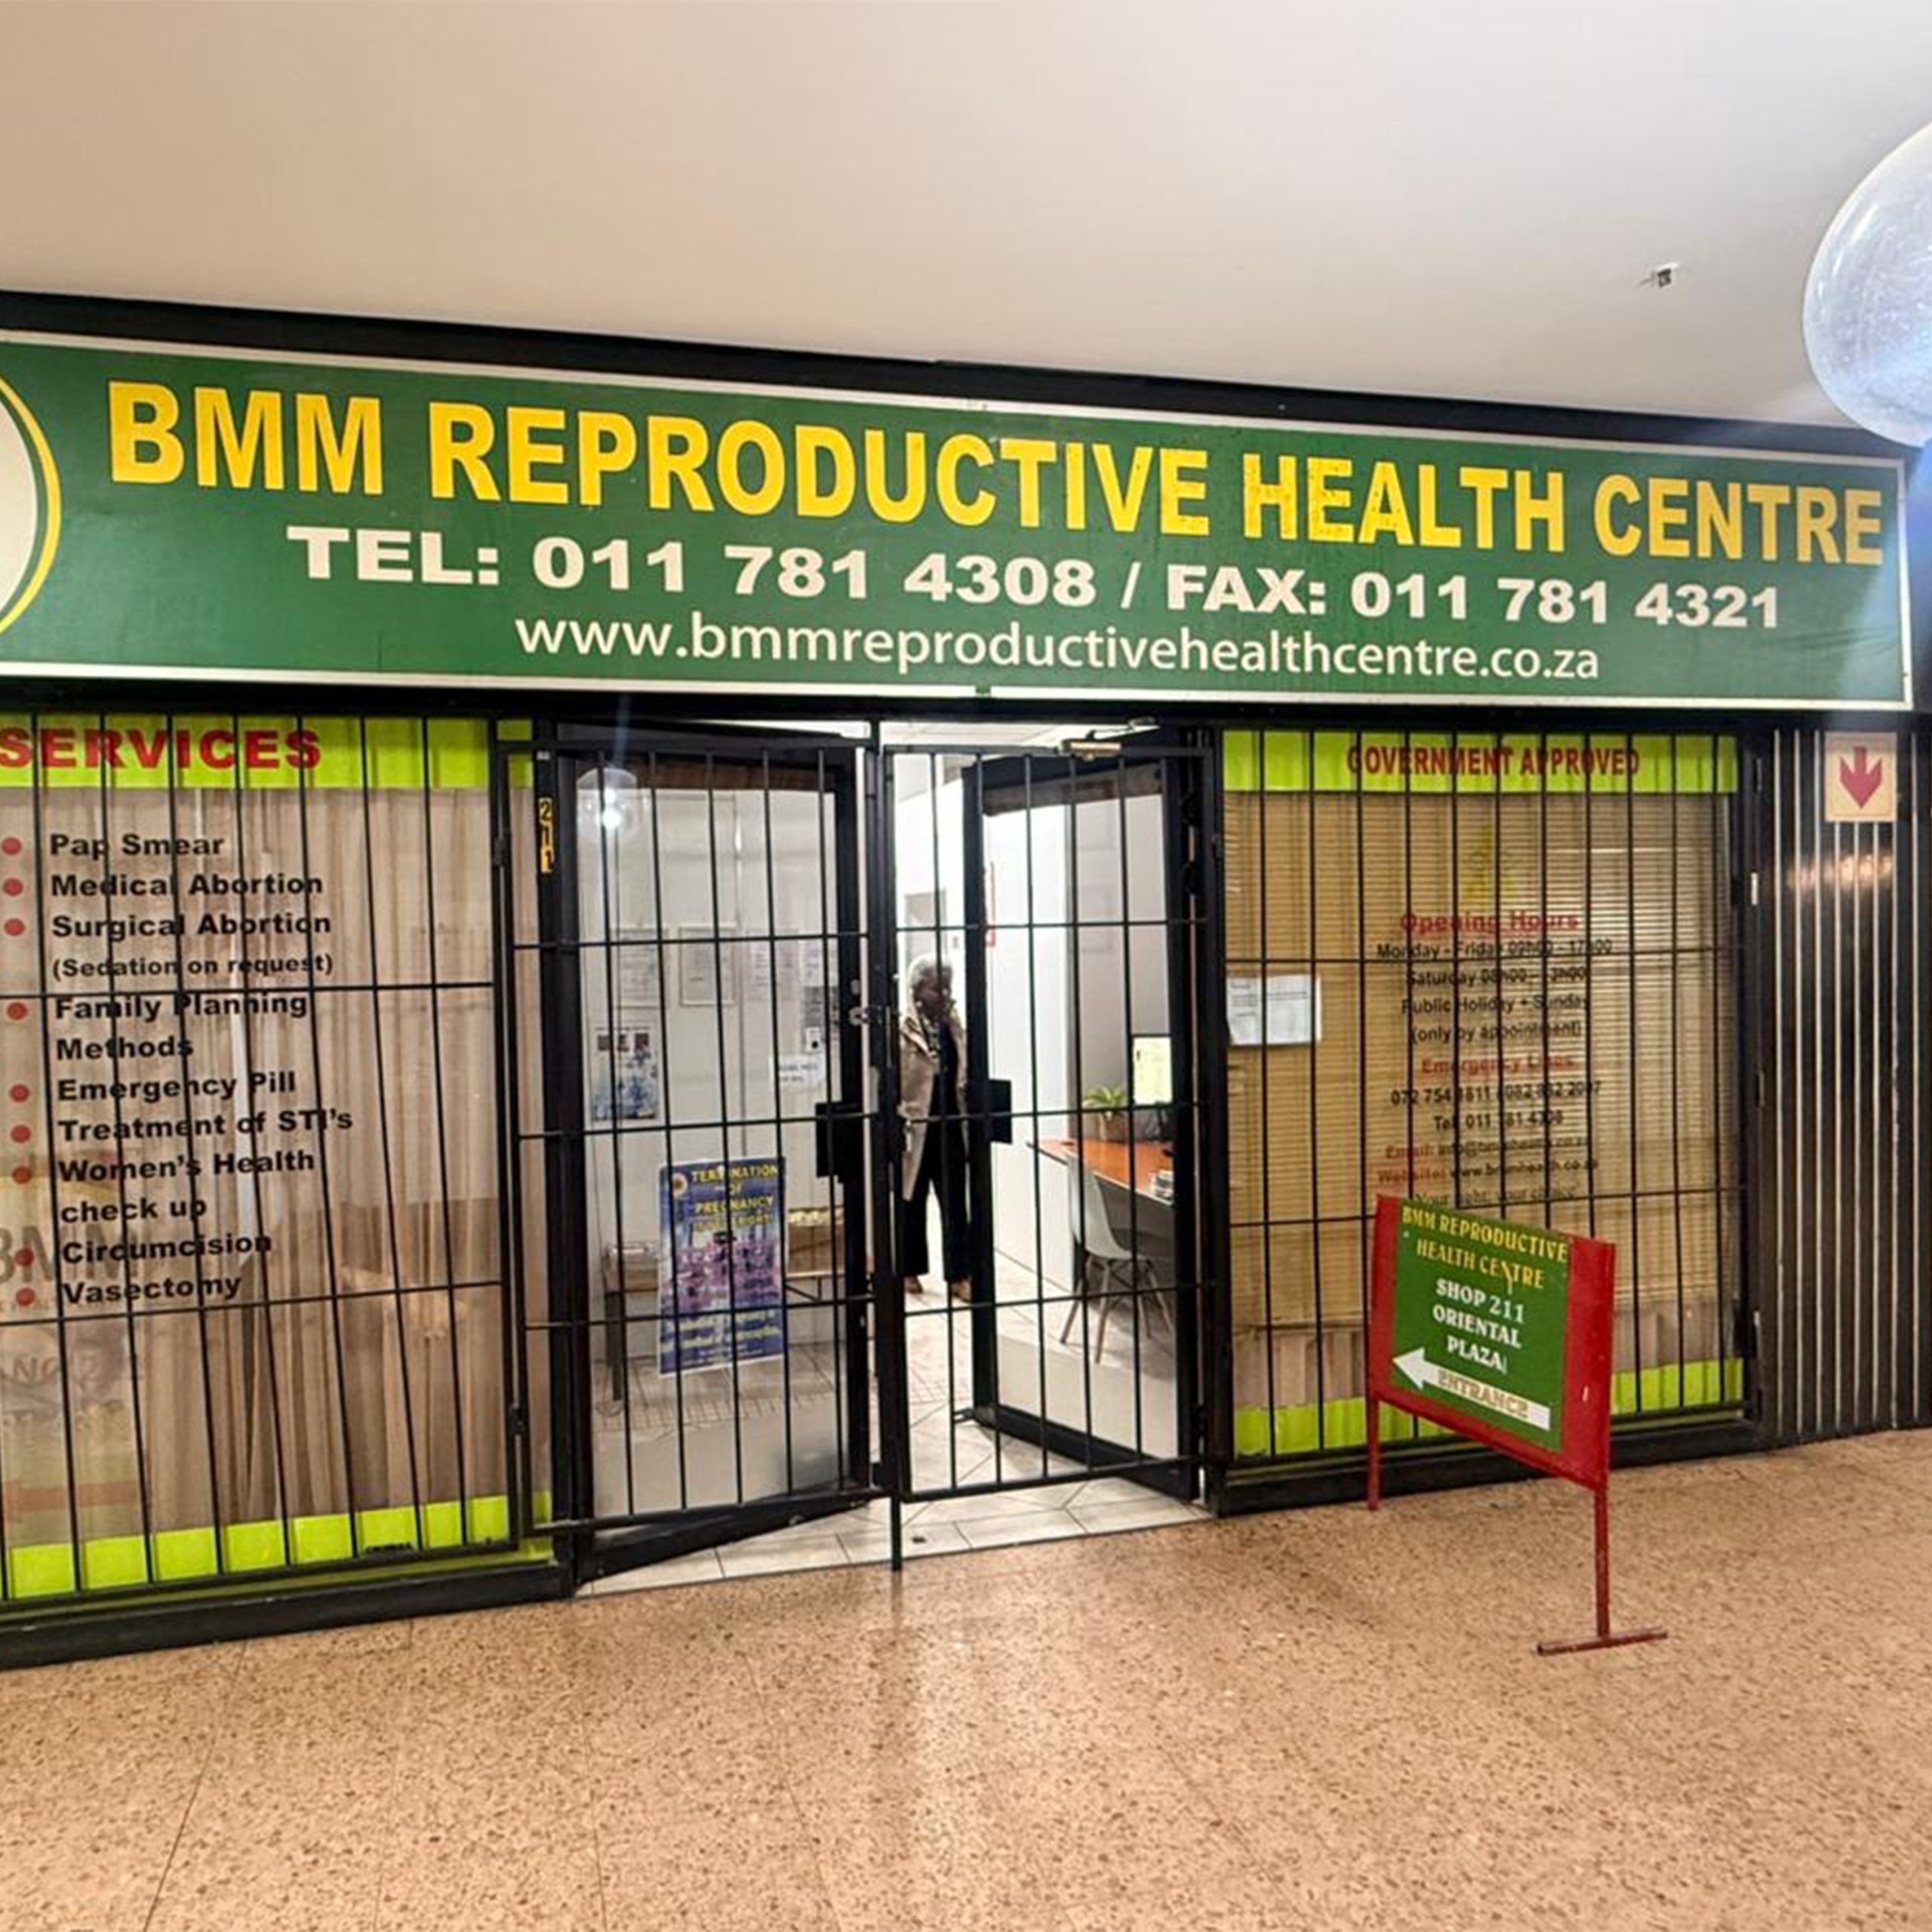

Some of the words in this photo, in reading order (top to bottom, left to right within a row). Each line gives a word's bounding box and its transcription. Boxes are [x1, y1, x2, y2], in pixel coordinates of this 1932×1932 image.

[109, 380, 383, 495] BMM
[429, 401, 1210, 536] REPRODUCTIVE
[1244, 454, 1564, 552] HEALTH
[1593, 474, 1884, 566] CENTRE
[287, 526, 500, 585] TEL:
[533, 537, 685, 592] 011
[724, 545, 866, 598] 781
[904, 553, 1097, 607] 4308
[1167, 565, 1326, 615] FAX:
[1351, 571, 1467, 620] 011
[1497, 579, 1607, 624] 781
[1635, 583, 1778, 629] 4321
[515, 611, 1599, 680] www.bmmreproductivehealthcentre.co.za
[0, 728, 321, 771] SERVICES
[51, 834, 109, 860] Pap
[122, 833, 226, 856] Smear
[51, 874, 175, 897] Medical
[189, 872, 323, 896] Abortion
[52, 915, 186, 942] Surgical
[198, 913, 331, 936] Abortion
[1570, 938, 1613, 955] 1700
[54, 958, 178, 980] (Sedation
[188, 958, 219, 974] on
[228, 953, 334, 978] request)
[56, 996, 162, 1022] Family
[174, 993, 308, 1019] Planning
[1534, 992, 1589, 1011] Sunda
[1479, 1020, 1583, 1041] appointent)
[57, 1036, 194, 1061] Methods
[1421, 1058, 1521, 1077] Emrgency
[58, 1076, 237, 1103] Emergency
[250, 1072, 296, 1094] Pill
[58, 1115, 226, 1142] Treatment
[237, 1111, 266, 1134] of
[214, 1150, 315, 1176] Health
[692, 1164, 778, 1185] TERMNATION
[61, 1198, 158, 1223] check
[170, 1199, 207, 1224] up
[1402, 1206, 1435, 1230] BMM
[1439, 1214, 1568, 1263] REPRODUCTIVE
[63, 1235, 272, 1264] Circumcision
[1417, 1238, 1475, 1271] HEALTH
[63, 1276, 242, 1305] Vasectomy
[1435, 1278, 1486, 1306] SHOP
[1489, 1295, 1525, 1324] 211
[1432, 1303, 1521, 1349] ORIENTAL
[1438, 1369, 1530, 1419] ENTRANCE
